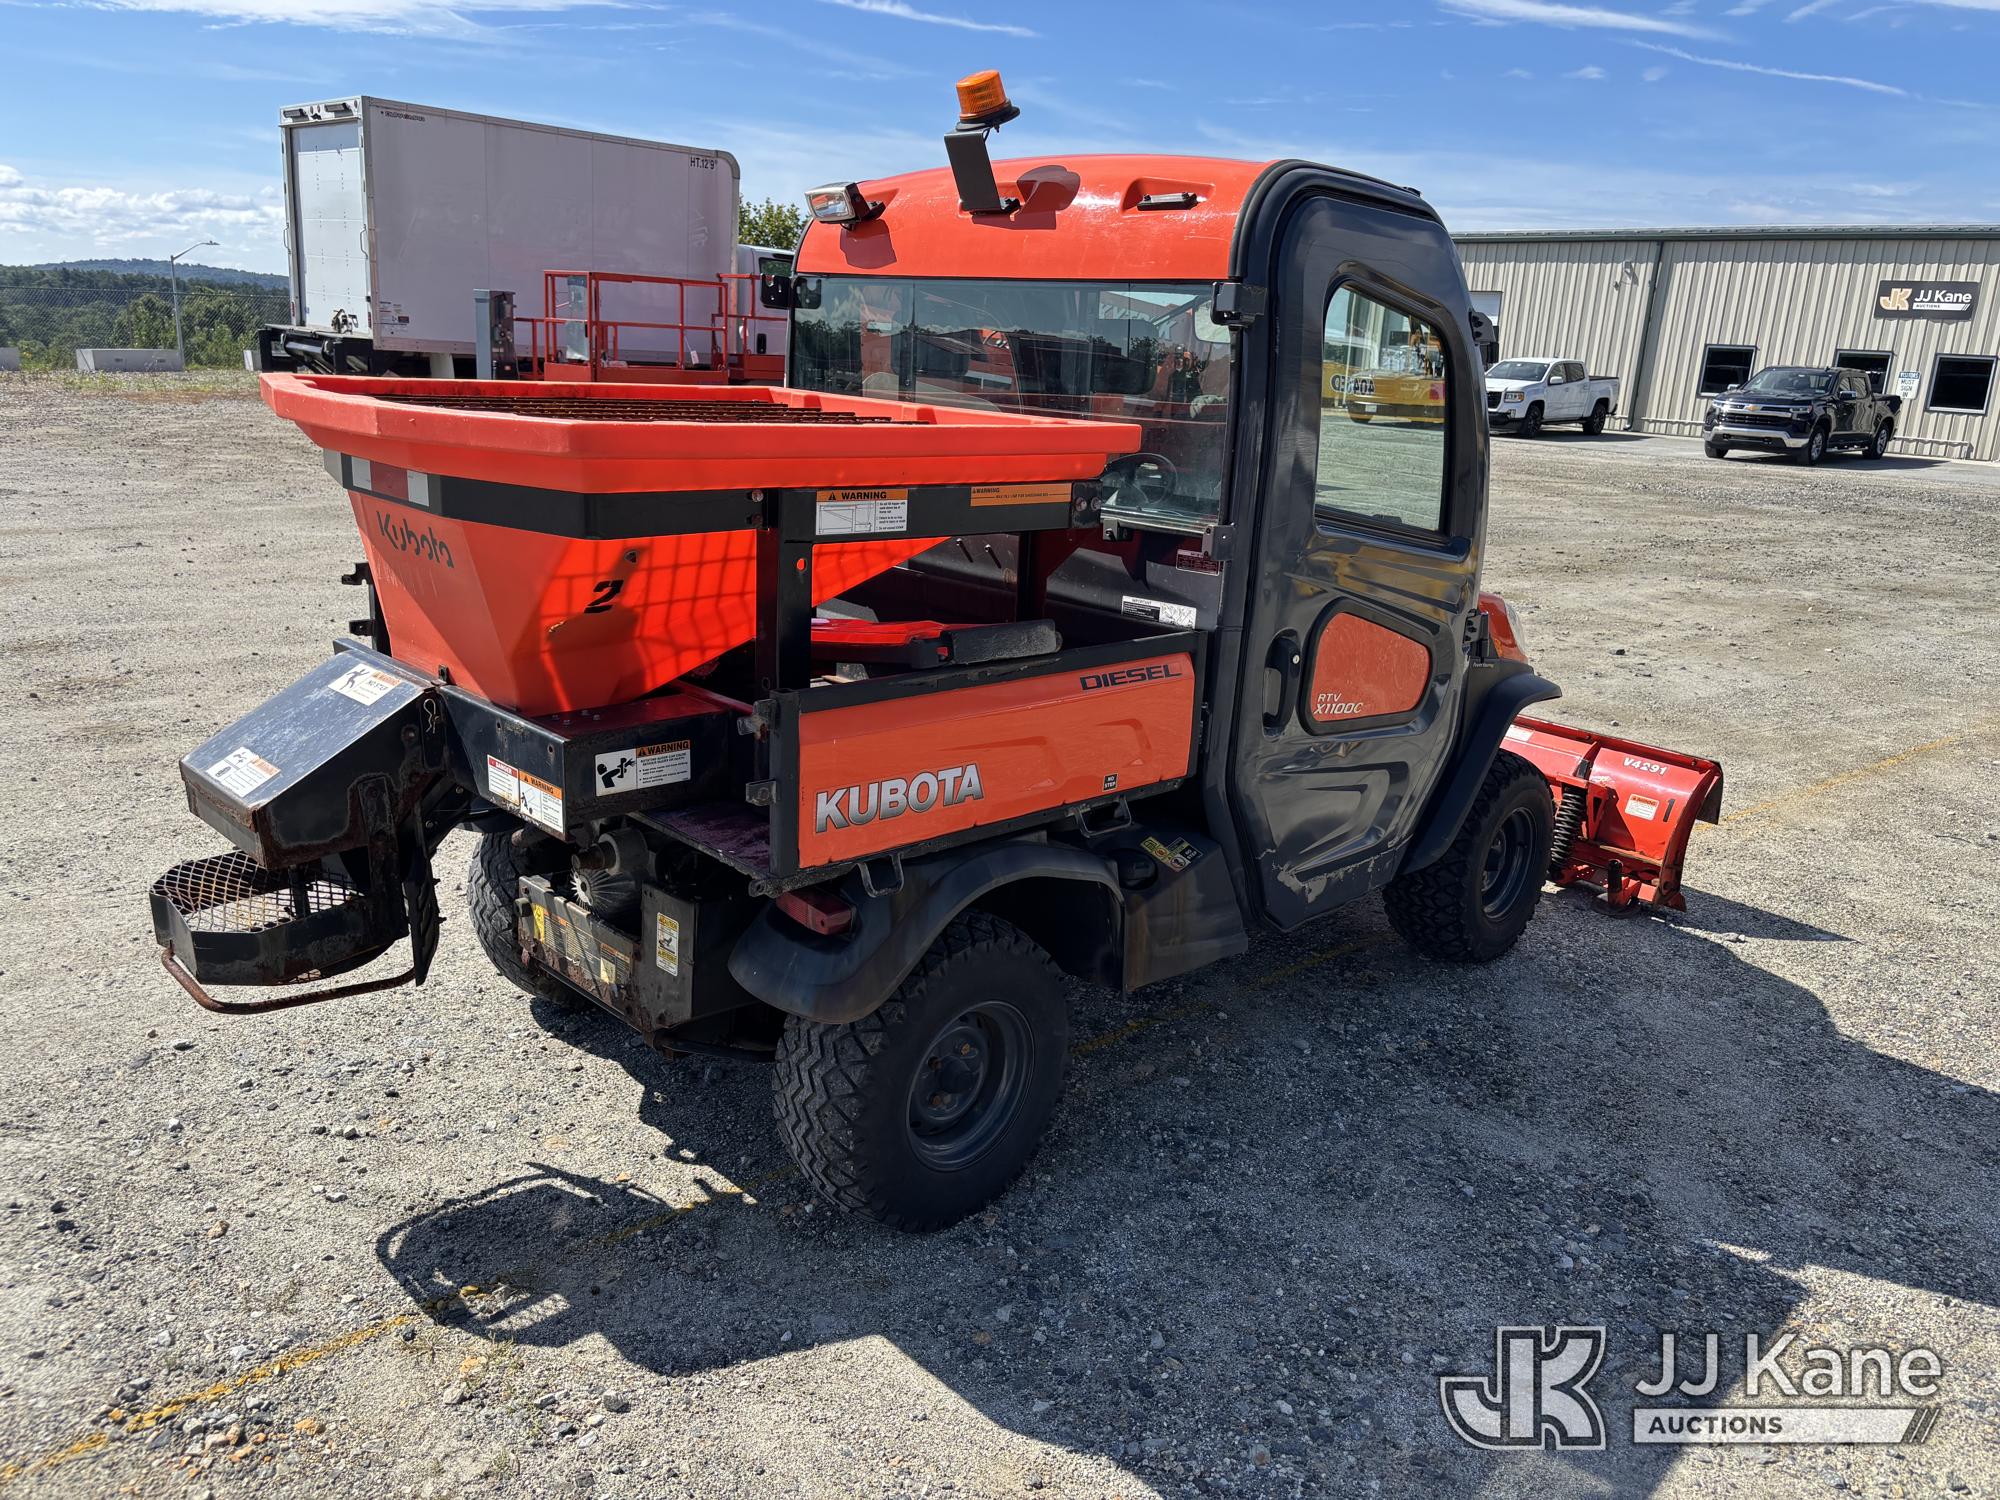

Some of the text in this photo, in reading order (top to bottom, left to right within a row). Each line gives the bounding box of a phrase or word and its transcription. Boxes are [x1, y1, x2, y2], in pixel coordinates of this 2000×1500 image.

[1914, 289, 1972, 303] JJ Kane
[841, 491, 887, 500] WARNING
[1080, 665, 1182, 690] DIESEL
[1318, 693, 1342, 702] RTV
[1313, 702, 1363, 715] X1100C
[647, 741, 689, 757] WARNING
[495, 761, 513, 775] DANGER
[1623, 757, 1667, 775] V4291
[530, 777, 554, 794] WARNING
[815, 763, 984, 833] KUBOTA
